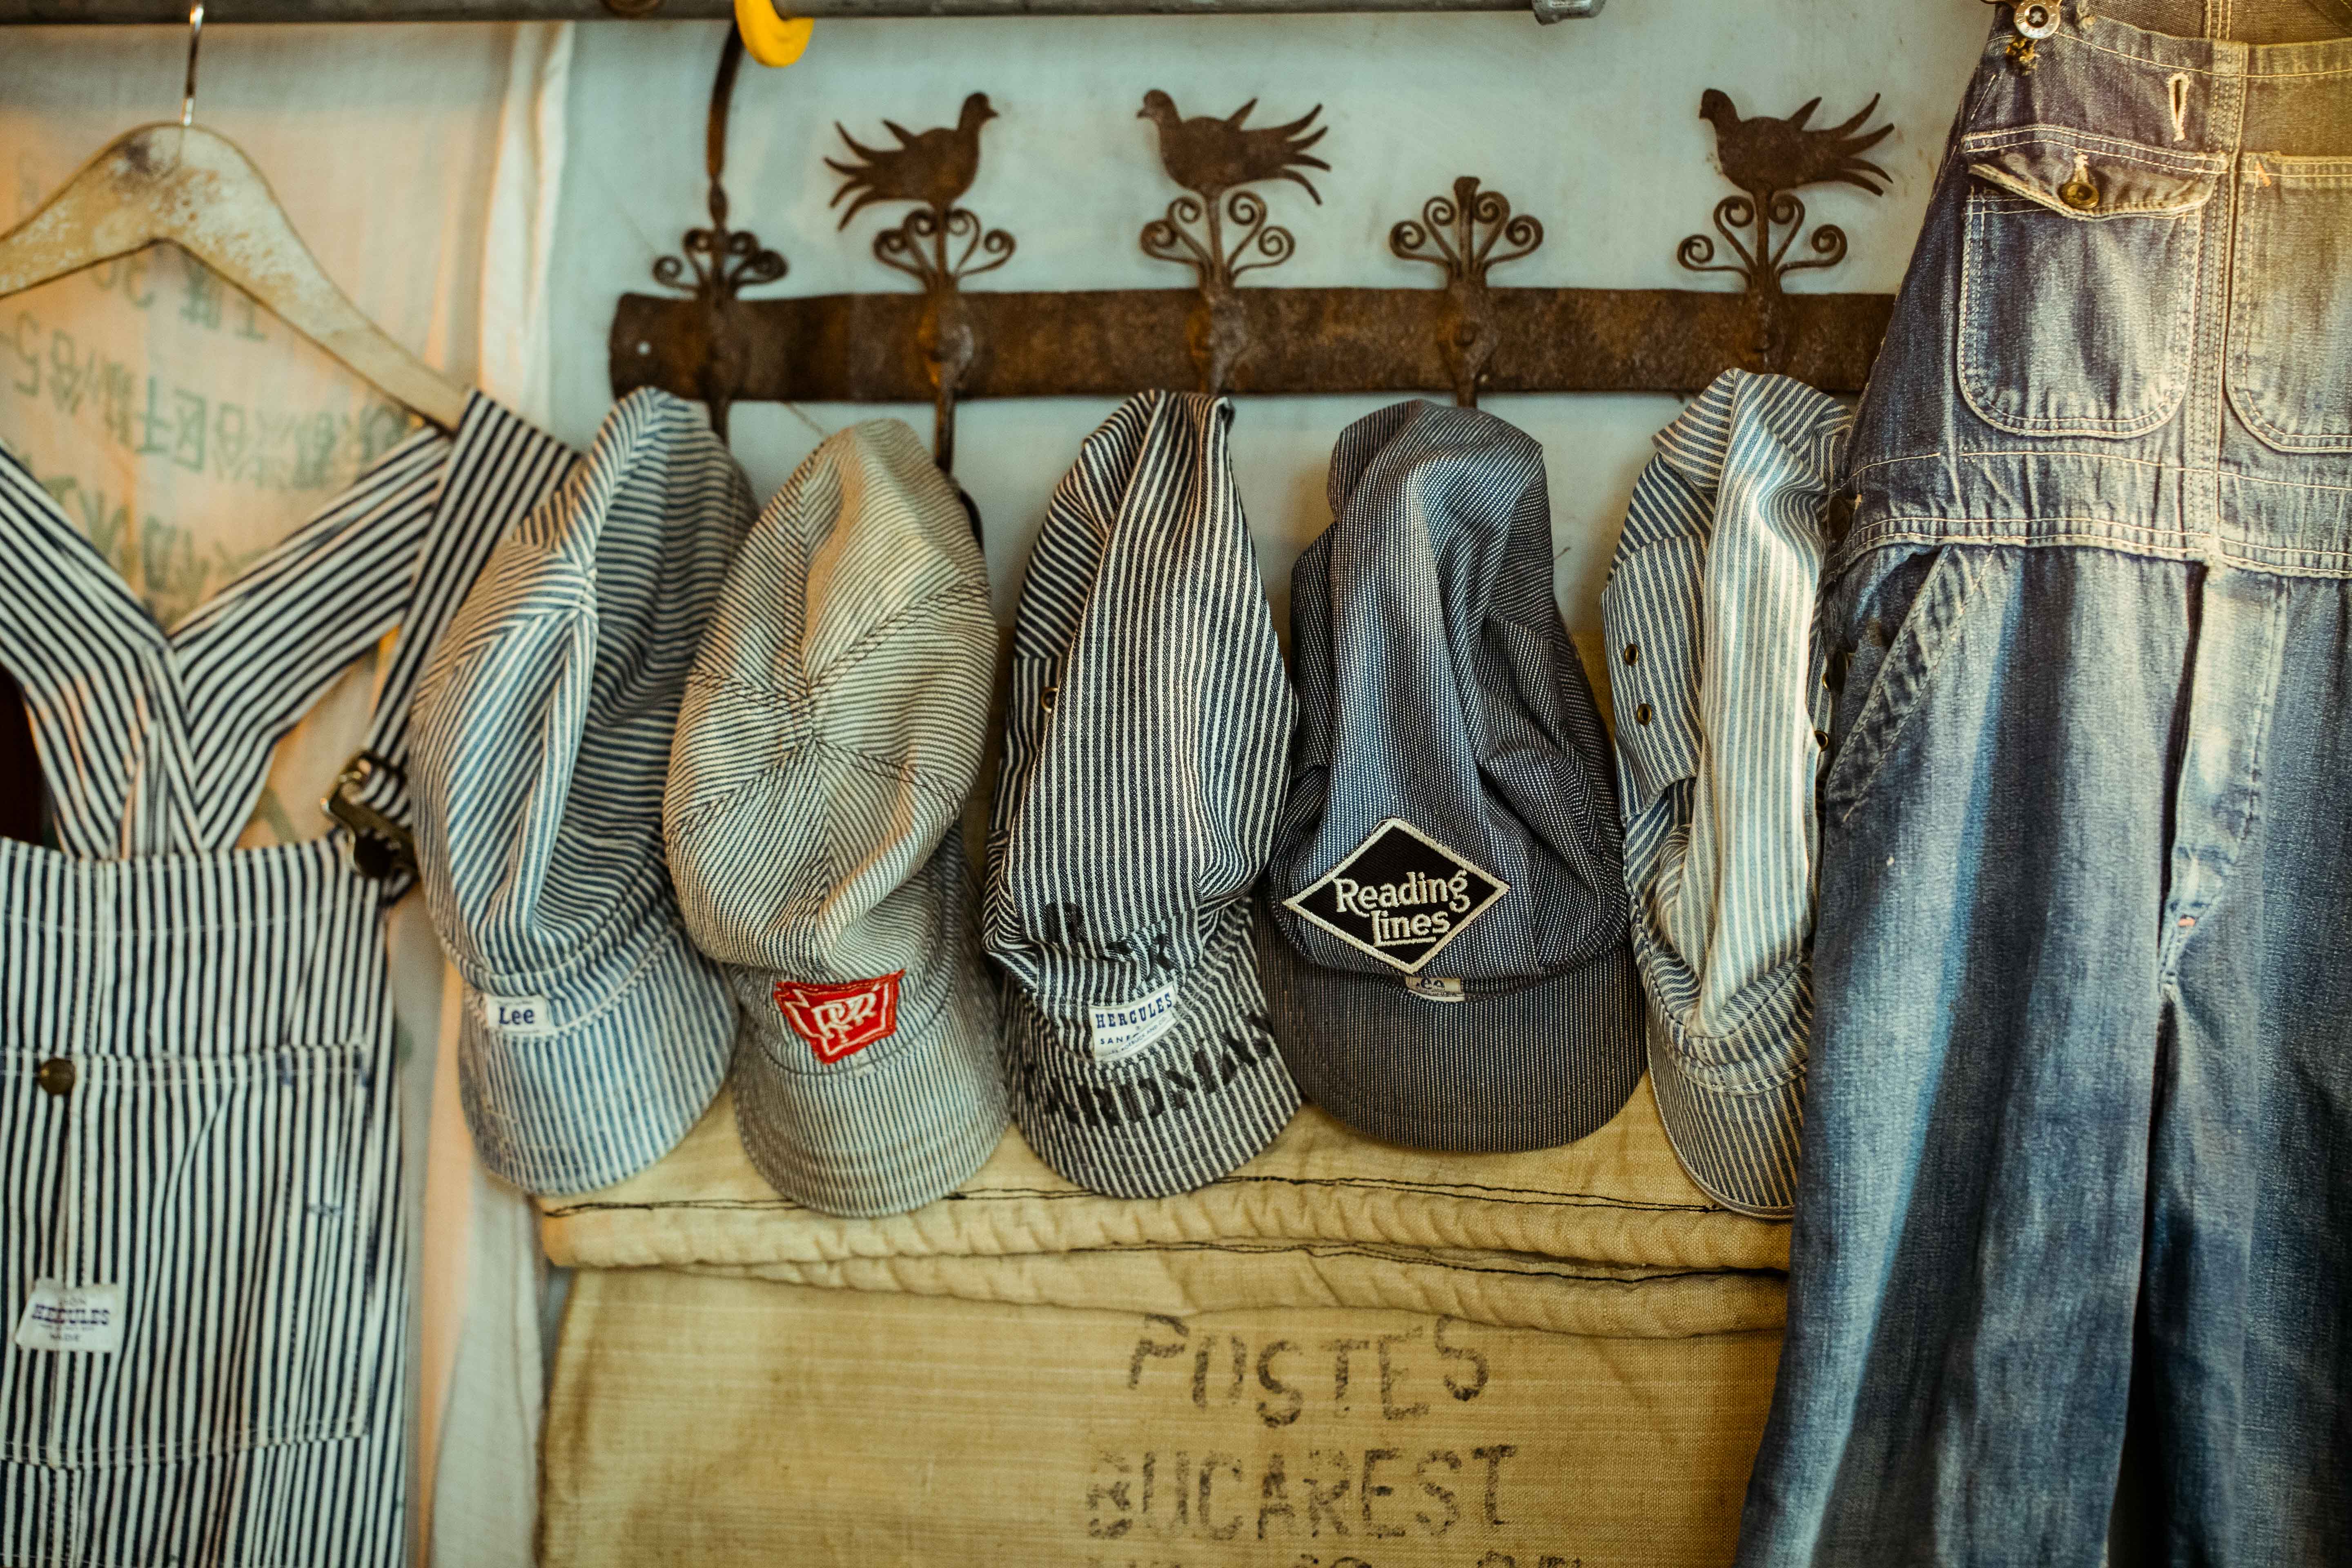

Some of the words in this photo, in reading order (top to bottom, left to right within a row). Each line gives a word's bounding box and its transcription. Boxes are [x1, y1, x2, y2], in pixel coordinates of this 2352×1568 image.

[1332, 869, 1470, 918] Reading
[1370, 910, 1450, 948] Lines
[499, 1006, 535, 1025] Lee
[1095, 992, 1173, 1029] HERCULES
[1086, 1445, 1517, 1540] BUCAREST
